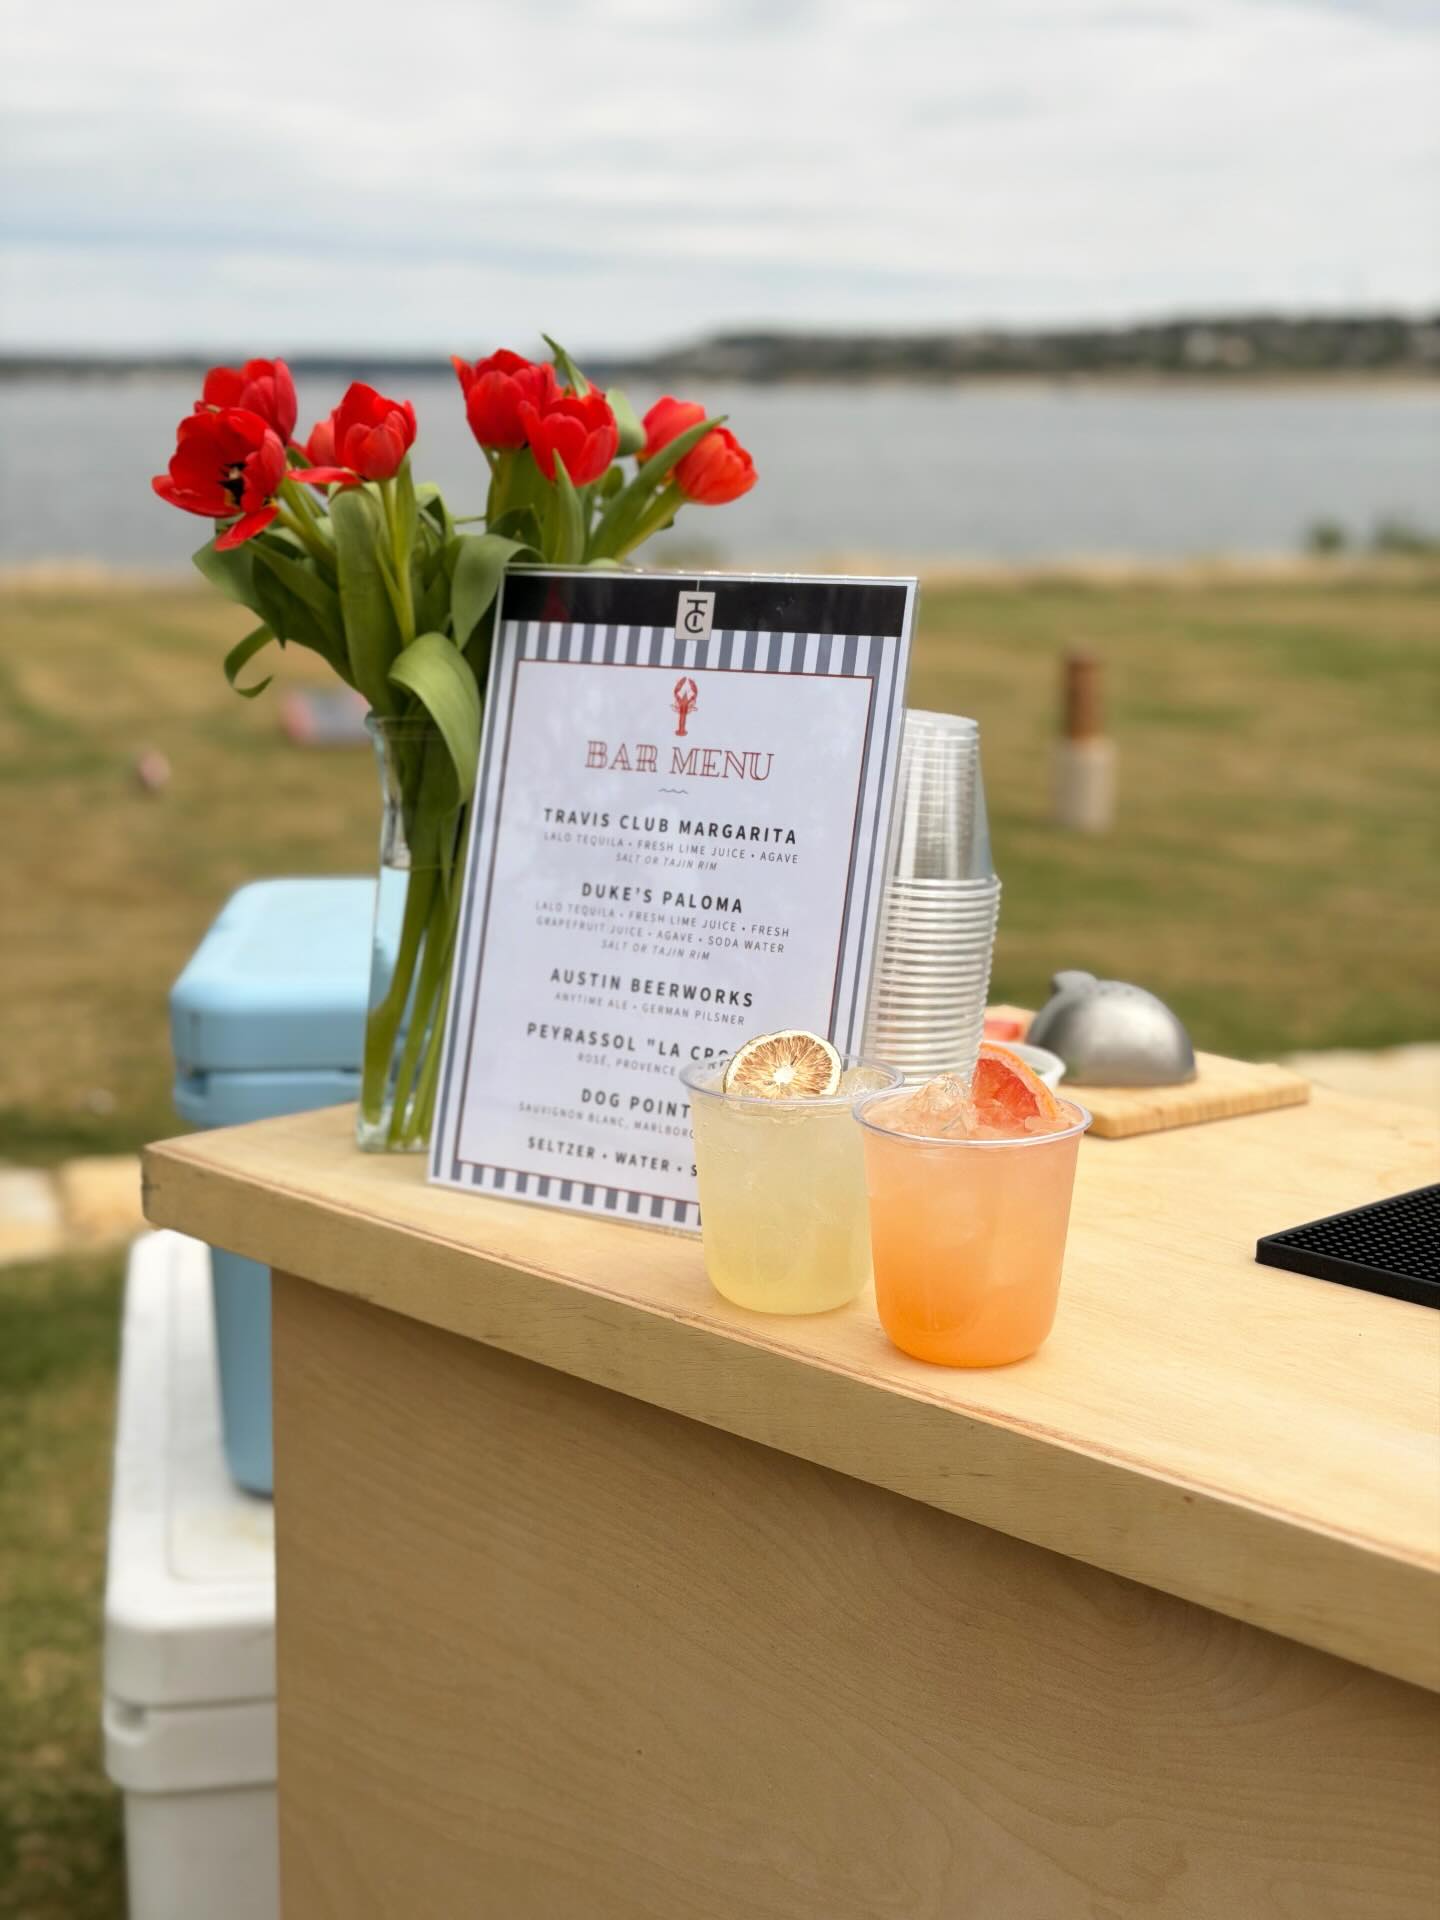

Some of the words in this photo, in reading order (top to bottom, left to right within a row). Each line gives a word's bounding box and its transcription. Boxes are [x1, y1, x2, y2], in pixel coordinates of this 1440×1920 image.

[585, 740, 658, 773] BAR
[669, 746, 775, 781] MENU
[544, 807, 610, 828] TRAVIS
[619, 815, 669, 833] CLUB
[678, 820, 797, 845] MARGARITA
[543, 831, 572, 844] LALO
[576, 833, 624, 848] TEQUILA
[637, 839, 674, 852] FRESH
[679, 843, 706, 856] LIME
[711, 846, 746, 859] JUICE
[760, 852, 799, 864] AGAVE
[615, 852, 640, 864] SALT
[644, 854, 659, 865] OR
[663, 857, 694, 869] TAJIN
[698, 860, 718, 871] RIM
[581, 882, 653, 904] DUKE'S
[662, 890, 743, 914] PALOMA
[535, 901, 563, 913] LALO
[567, 903, 616, 918] TEQUILA
[628, 910, 665, 924] FRESH
[670, 915, 697, 928] LIME
[701, 918, 737, 932] JUICE
[751, 923, 790, 938] FRESH
[535, 915, 606, 931] GRAPEFRUIT
[609, 924, 643, 937] JUICE
[656, 930, 693, 943] AGAVE
[707, 935, 739, 949] SODA
[743, 940, 785, 954] WATER
[600, 938, 628, 951] SALT
[632, 942, 647, 953] OR
[652, 944, 685, 958] TAJIN
[689, 949, 711, 961] RIM
[550, 968, 622, 991] AUSTIN
[630, 977, 754, 1008] BEERWORKS
[554, 991, 603, 1007] ANYTIME
[607, 999, 628, 1011] ALE
[641, 1002, 689, 1018] GERMAN
[694, 1009, 745, 1026] PILSNER
[527, 1021, 636, 1052] PEYRASSOL
[615, 1058, 676, 1077] PROVENCE
[518, 1101, 584, 1121] SAUVIGNON
[587, 1111, 630, 1130] BLANC,
[581, 1088, 621, 1108] DOG
[629, 1096, 691, 1119] POINT
[527, 1135, 596, 1160] SELTZER
[614, 1151, 670, 1173] WATER
